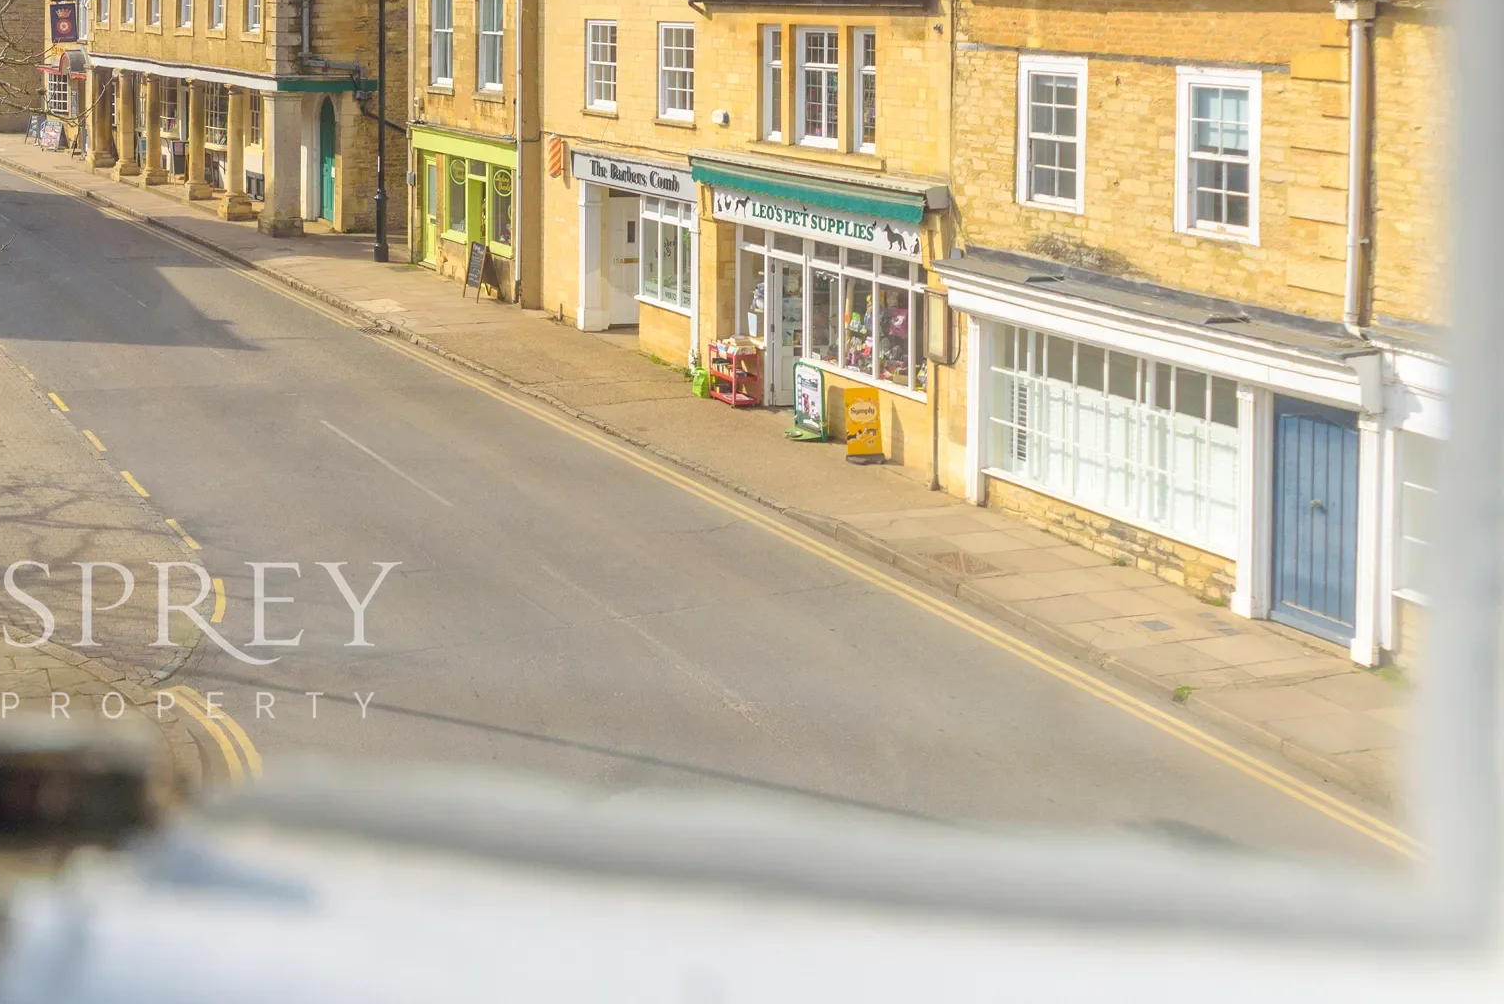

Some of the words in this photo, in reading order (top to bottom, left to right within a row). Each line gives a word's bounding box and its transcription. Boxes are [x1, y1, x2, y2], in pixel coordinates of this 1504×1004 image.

[590, 159, 607, 178] The
[610, 163, 647, 187] Barbers
[649, 170, 680, 193] Comb
[752, 203, 783, 222] LEO'S
[784, 209, 809, 228] PET
[810, 214, 874, 242] SUPPLIES
